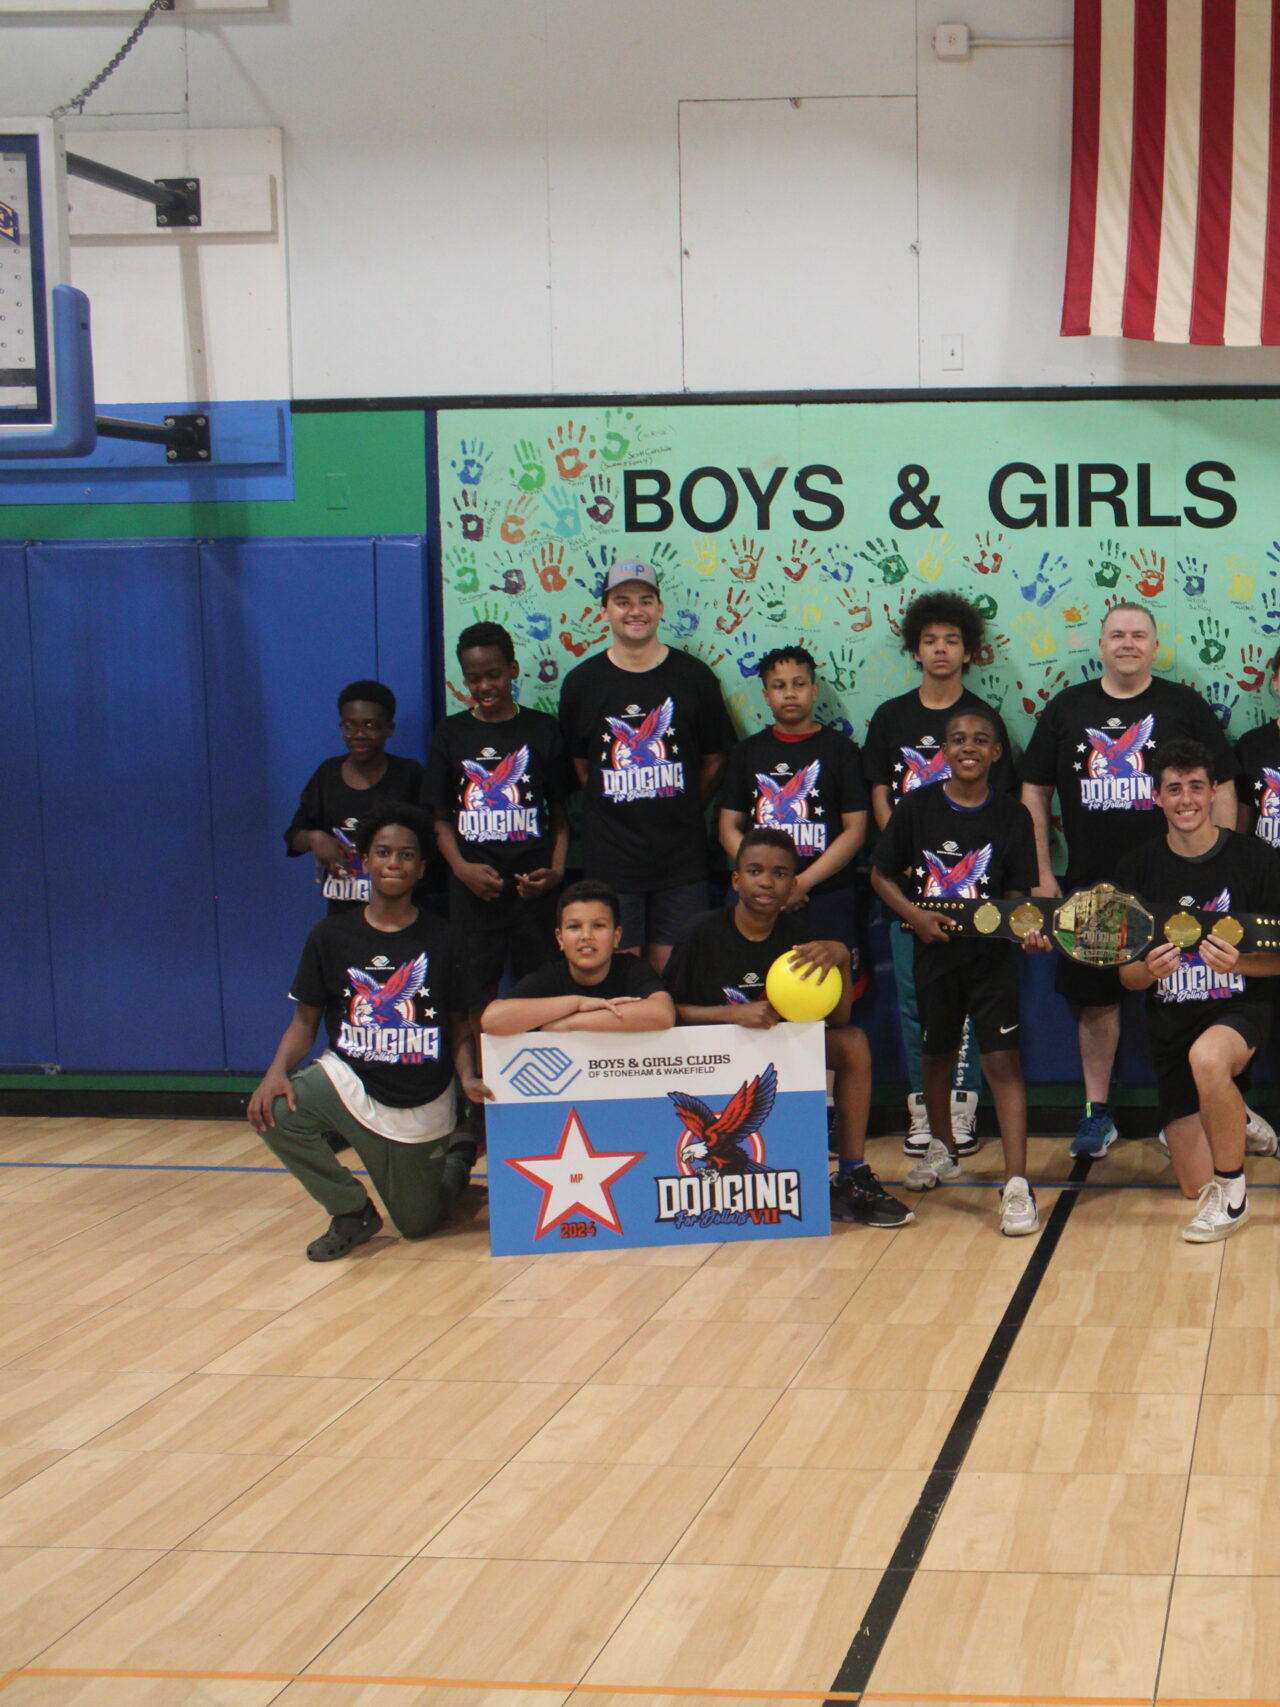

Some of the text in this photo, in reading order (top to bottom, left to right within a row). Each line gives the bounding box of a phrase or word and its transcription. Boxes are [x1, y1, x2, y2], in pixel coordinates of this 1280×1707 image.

[623, 464, 845, 533] BOYS
[889, 463, 946, 531] &
[988, 461, 1238, 530] GIRLS
[601, 762, 685, 795] DODGING
[1080, 776, 1155, 804] DODGIN
[1088, 799, 1101, 811] For
[1102, 798, 1132, 811] Dollars
[1176, 988, 1209, 1003] Dollars
[337, 1021, 439, 1060] DODGING
[588, 1054, 731, 1070] BOYS & GIRLS CLUBS
[588, 1066, 715, 1078] OF STONEHAM & WAKEFIELD
[570, 1173, 584, 1184] MP
[655, 1170, 802, 1221] DODGING
[674, 1208, 781, 1229] For Dollars VII
[561, 1221, 597, 1239] 2024
